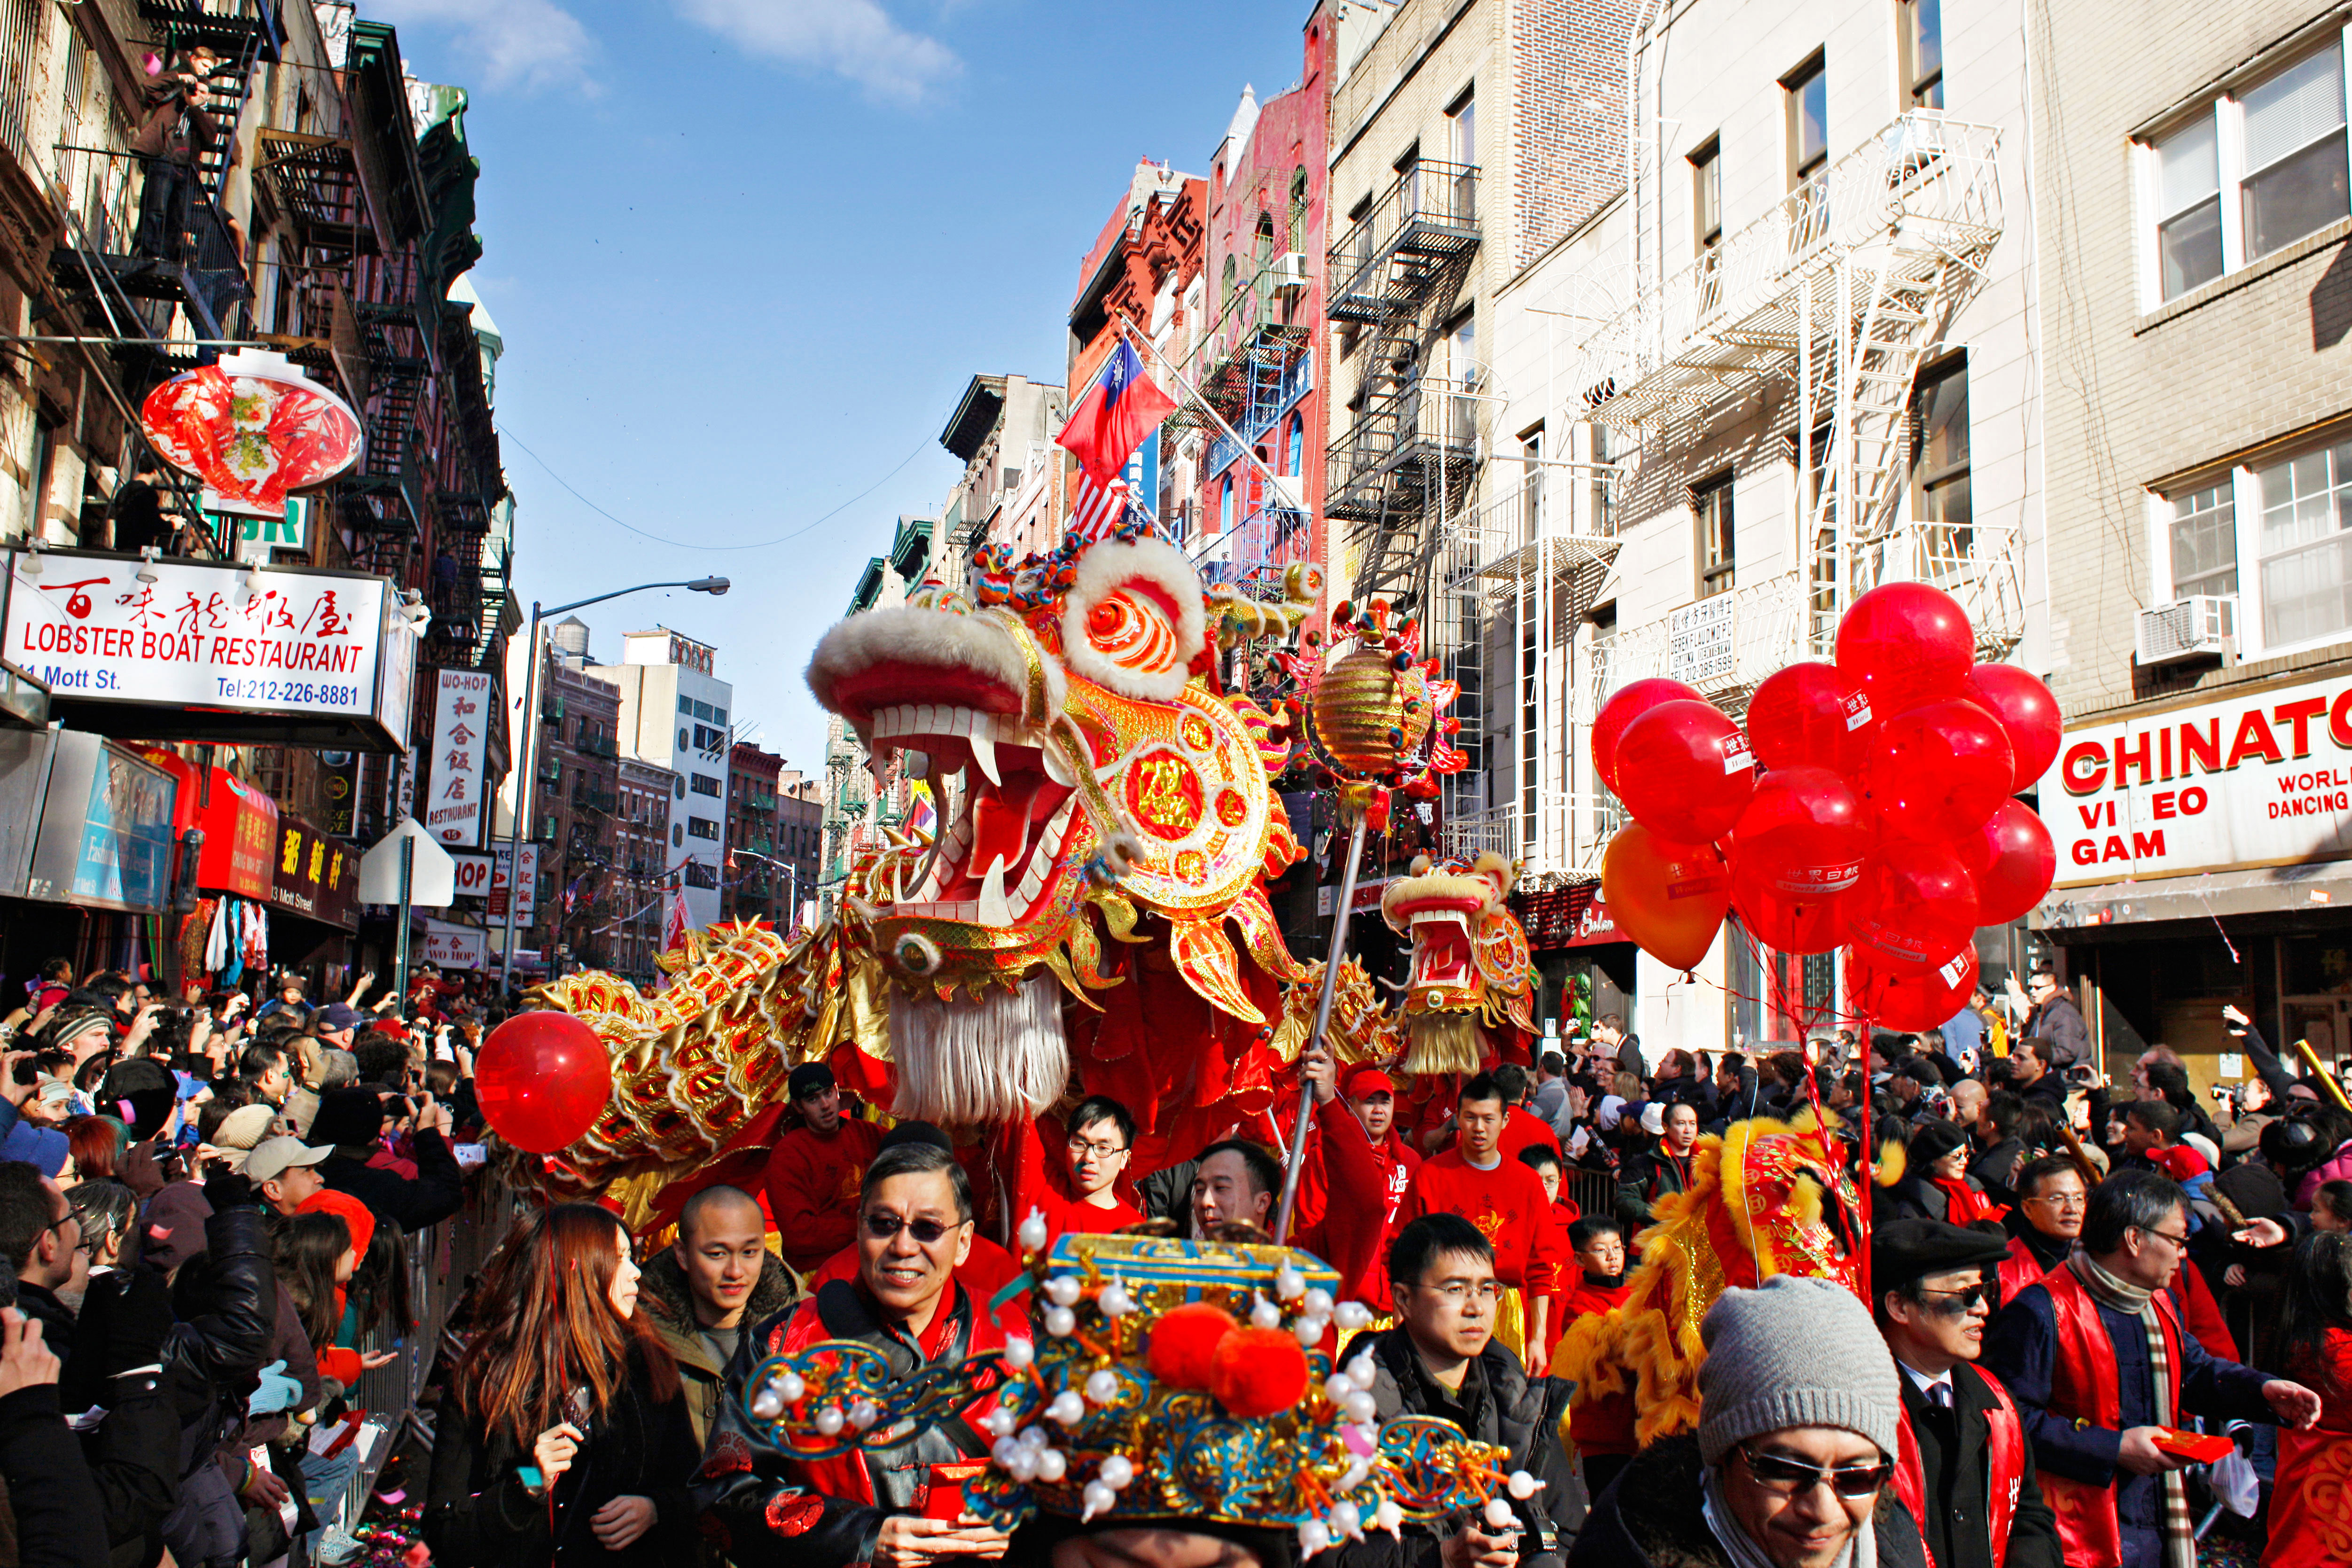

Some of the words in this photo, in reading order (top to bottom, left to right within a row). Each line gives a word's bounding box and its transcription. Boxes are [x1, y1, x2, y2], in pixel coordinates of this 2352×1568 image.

[24, 622, 134, 657] LOBSTER
[141, 632, 204, 663] BOAT
[211, 638, 363, 673] RESTAURANT
[1671, 634, 1689, 655] DEREK
[1698, 640, 1730, 661] DENTISTRY
[44, 665, 89, 687] Mott
[95, 669, 121, 690] St.
[1685, 655, 1732, 682] 212-385-1599
[217, 677, 359, 706] Tel:212-226-8881
[442, 673, 487, 691] WO-HOP
[1847, 694, 1868, 713] 世界
[444, 696, 477, 800] 和合飯店
[1726, 735, 1750, 754] 世界
[2278, 766, 2352, 794] WORL
[429, 803, 478, 825] RESTAURANT
[2268, 791, 2349, 819] DANCING
[446, 830, 457, 839] 15
[2071, 829, 2166, 866] GAM
[280, 888, 295, 906] Mott
[295, 893, 313, 912] Street
[429, 950, 447, 960] WO
[452, 951, 476, 961] HOP
